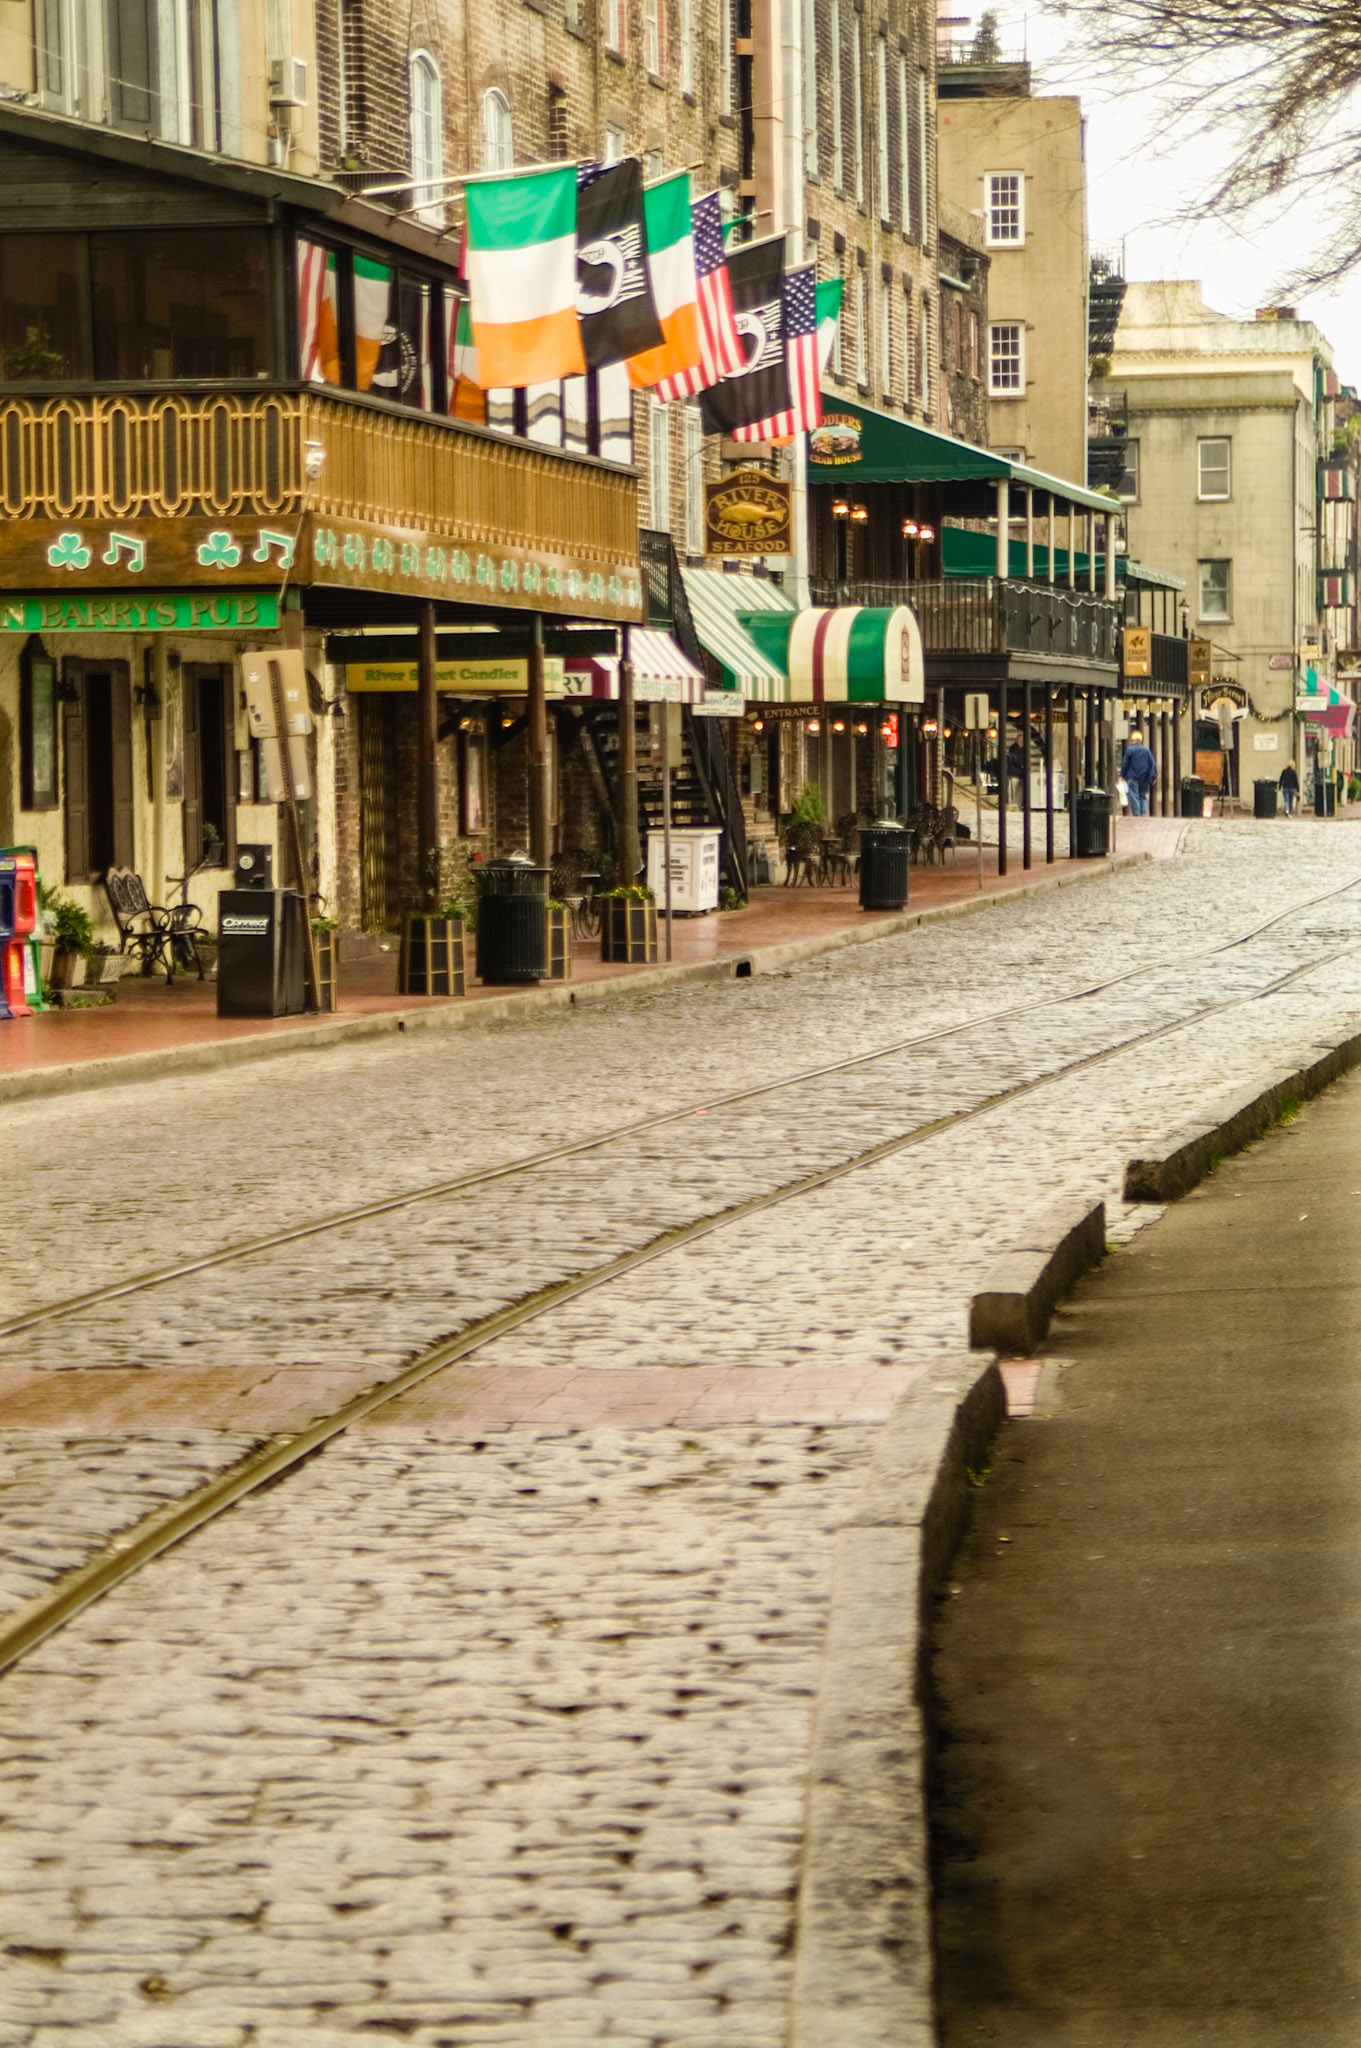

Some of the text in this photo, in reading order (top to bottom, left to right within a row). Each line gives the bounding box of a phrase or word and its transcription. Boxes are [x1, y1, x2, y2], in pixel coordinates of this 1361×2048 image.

[834, 451, 863, 466] HOUSE
[738, 473, 761, 485] 125
[714, 487, 781, 510] RIVER
[716, 519, 781, 540] HOUSE
[711, 539, 787, 553] SEAFOOD
[41, 599, 177, 629] BARRY'S
[189, 598, 258, 627] PUB
[365, 667, 519, 682] River Seet Candles
[763, 706, 821, 719] ENTRANCE
